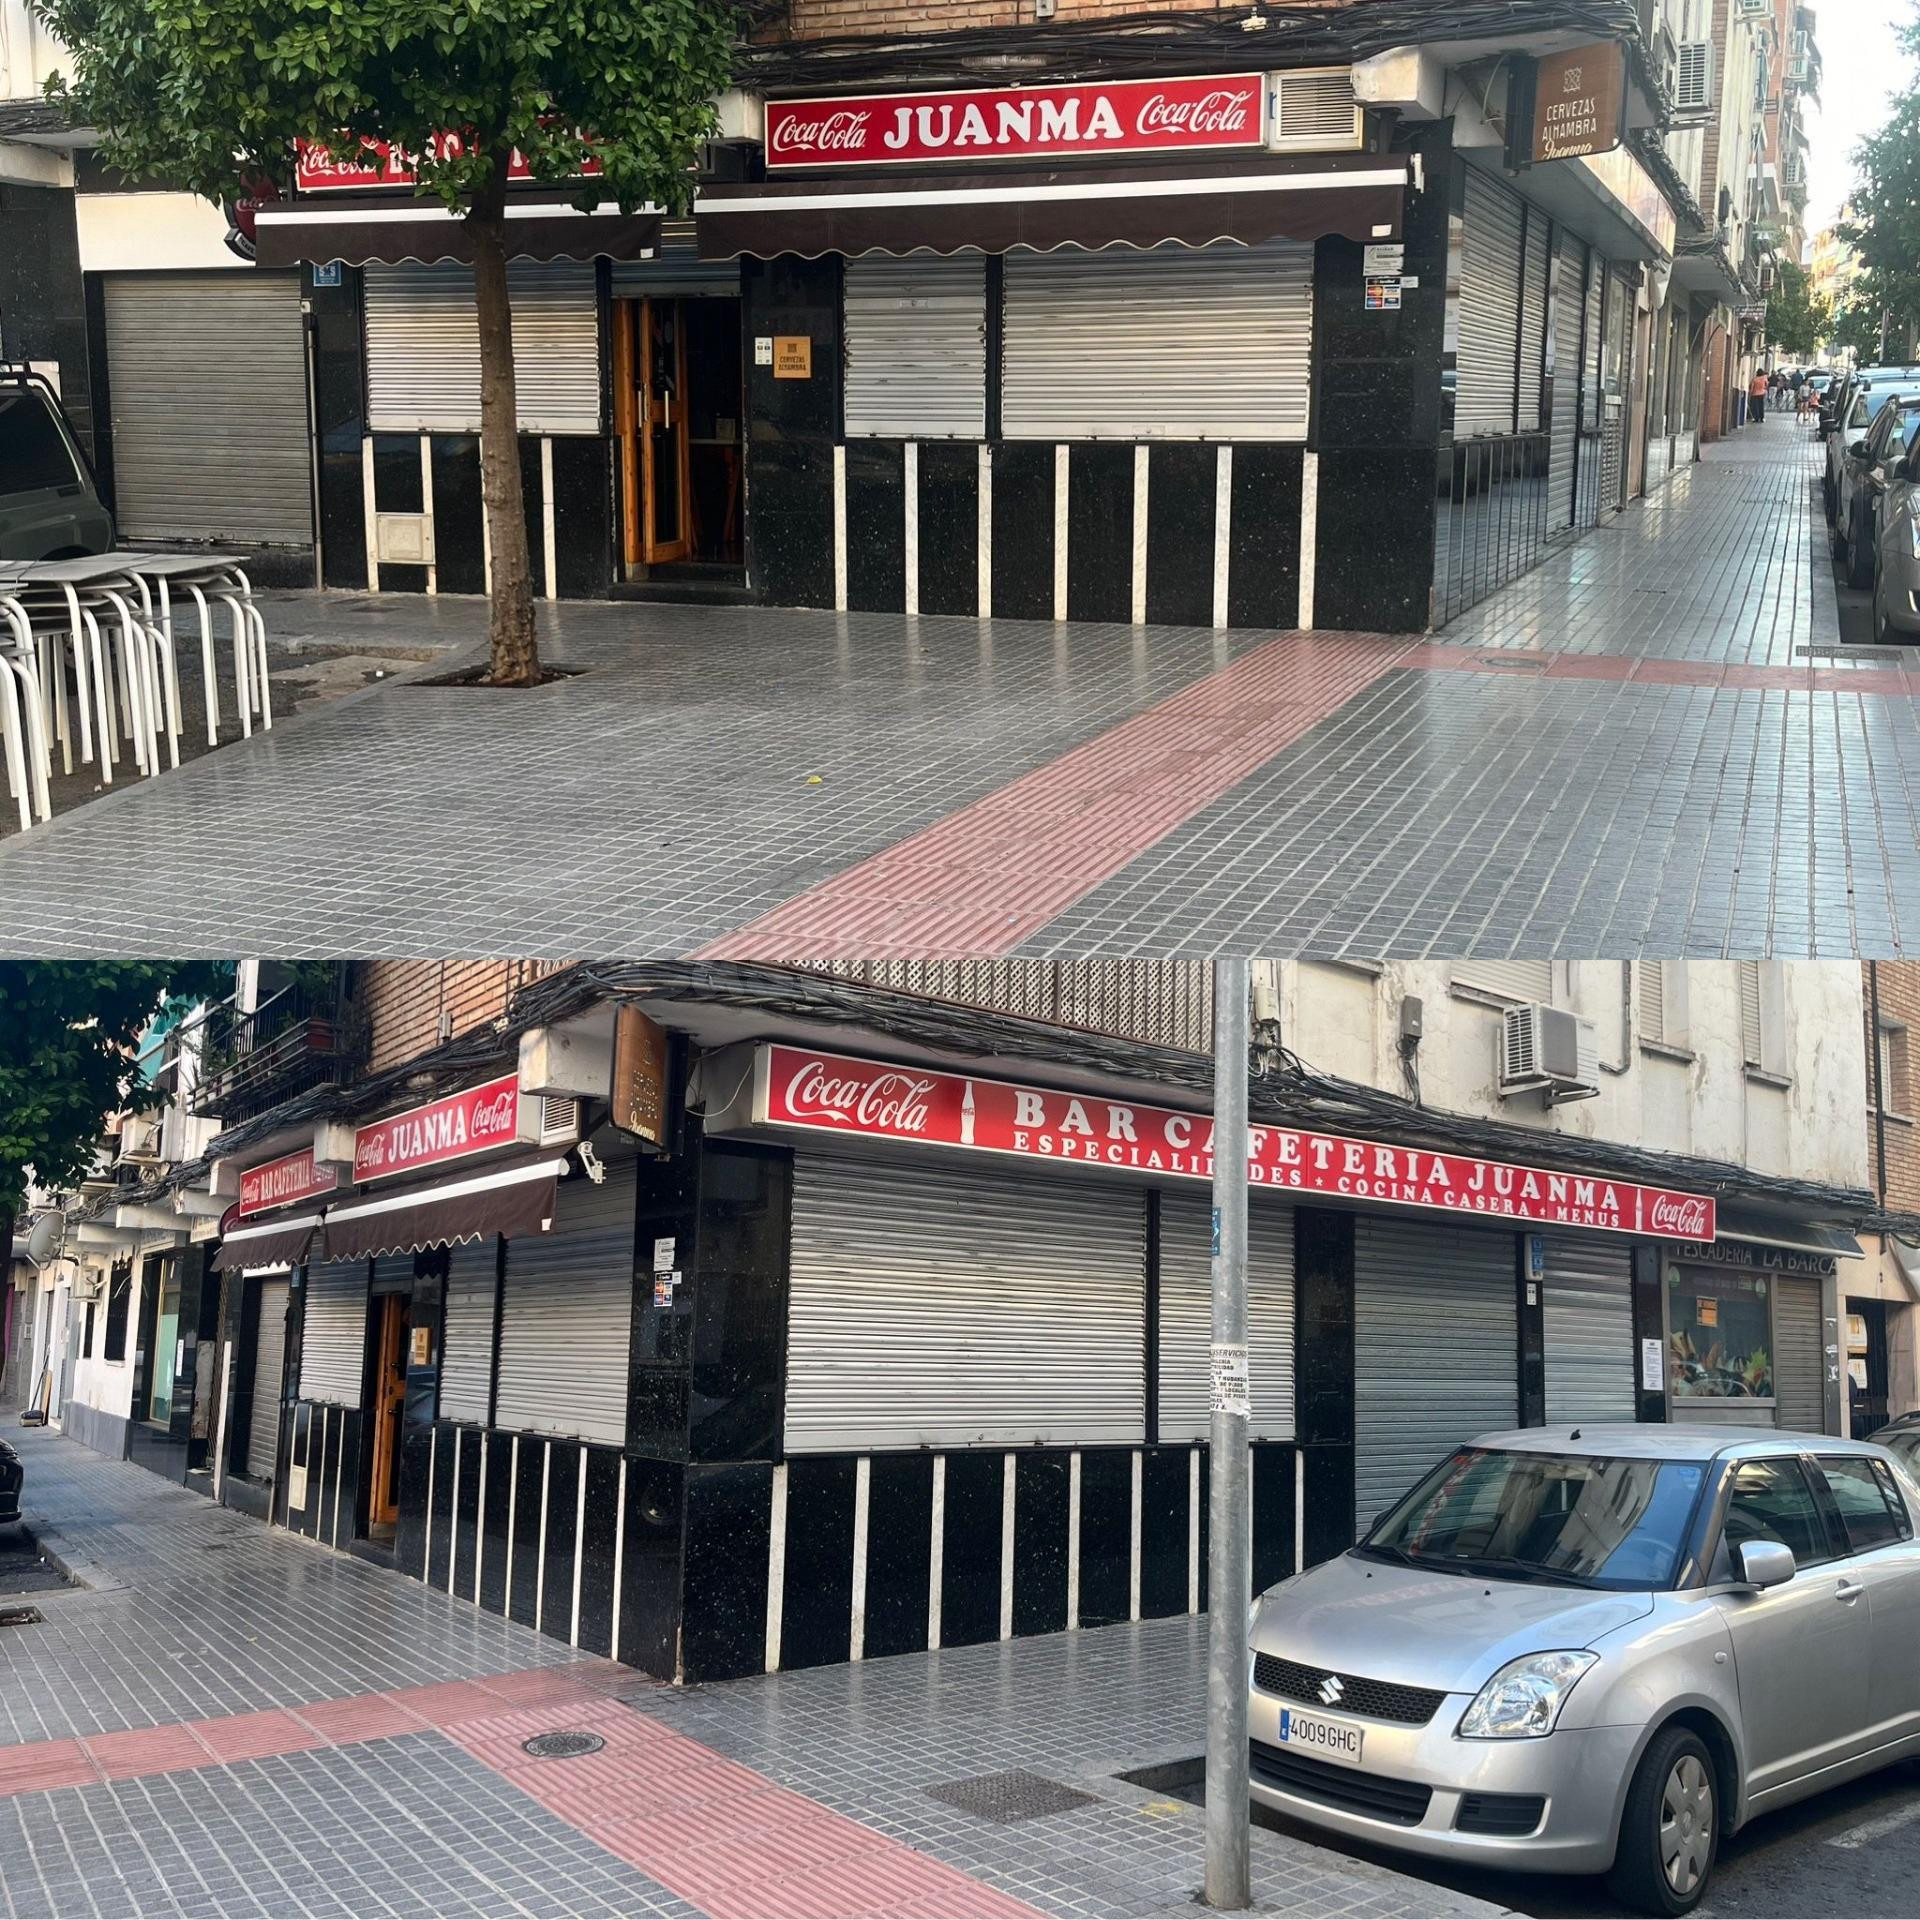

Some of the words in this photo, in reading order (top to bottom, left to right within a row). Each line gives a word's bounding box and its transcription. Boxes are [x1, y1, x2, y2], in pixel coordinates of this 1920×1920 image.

[773, 111, 872, 151] Coca-Cola
[884, 96, 1124, 149] JUANMA
[1136, 90, 1253, 135] Coca-Cola
[1541, 118, 1597, 141] ALHAMBRA
[1546, 98, 1596, 121] CERVEZAS
[388, 1105, 467, 1163] JUANMA
[471, 1090, 515, 1138] Coca-Cola
[785, 1061, 937, 1133] Coca-Cola
[1012, 1131, 1302, 1186] ESPECIALIDES
[1337, 1176, 1433, 1203] COCINA
[1444, 1190, 1530, 1216] CASERA
[1556, 1205, 1620, 1227] MENUS
[1013, 1090, 1138, 1142] BAR
[1467, 1163, 1620, 1210] JUANMA
[1652, 1195, 1707, 1235] Coca-Cola
[1762, 1251, 1783, 1269] LA
[1787, 1252, 1838, 1274] BARCA
